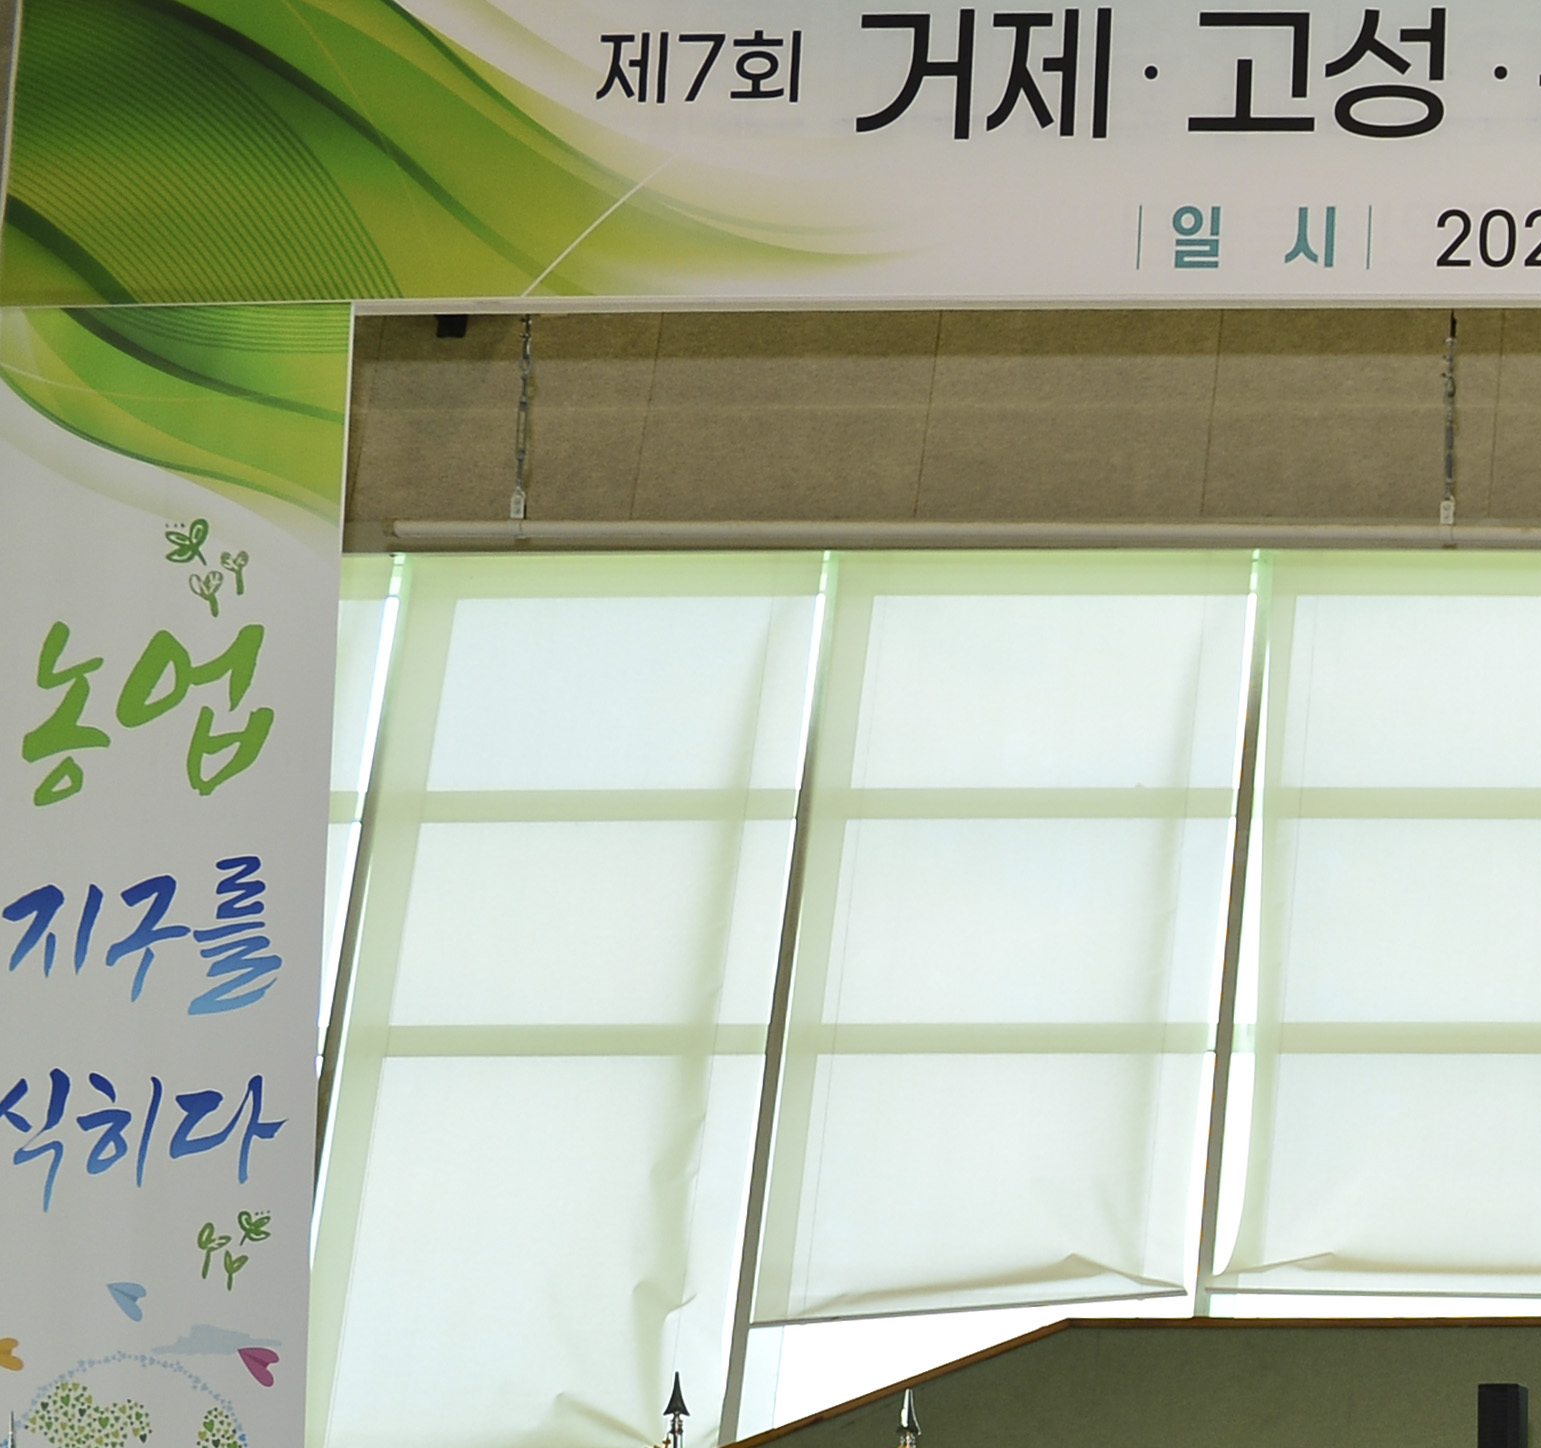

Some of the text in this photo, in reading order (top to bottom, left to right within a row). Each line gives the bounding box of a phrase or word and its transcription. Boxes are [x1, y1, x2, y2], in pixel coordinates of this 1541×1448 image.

[596, 30, 802, 103] 제7회
[22, 621, 275, 807] 농업
[1, 856, 282, 1016] 지구를
[0, 1067, 290, 1213] 식히다
